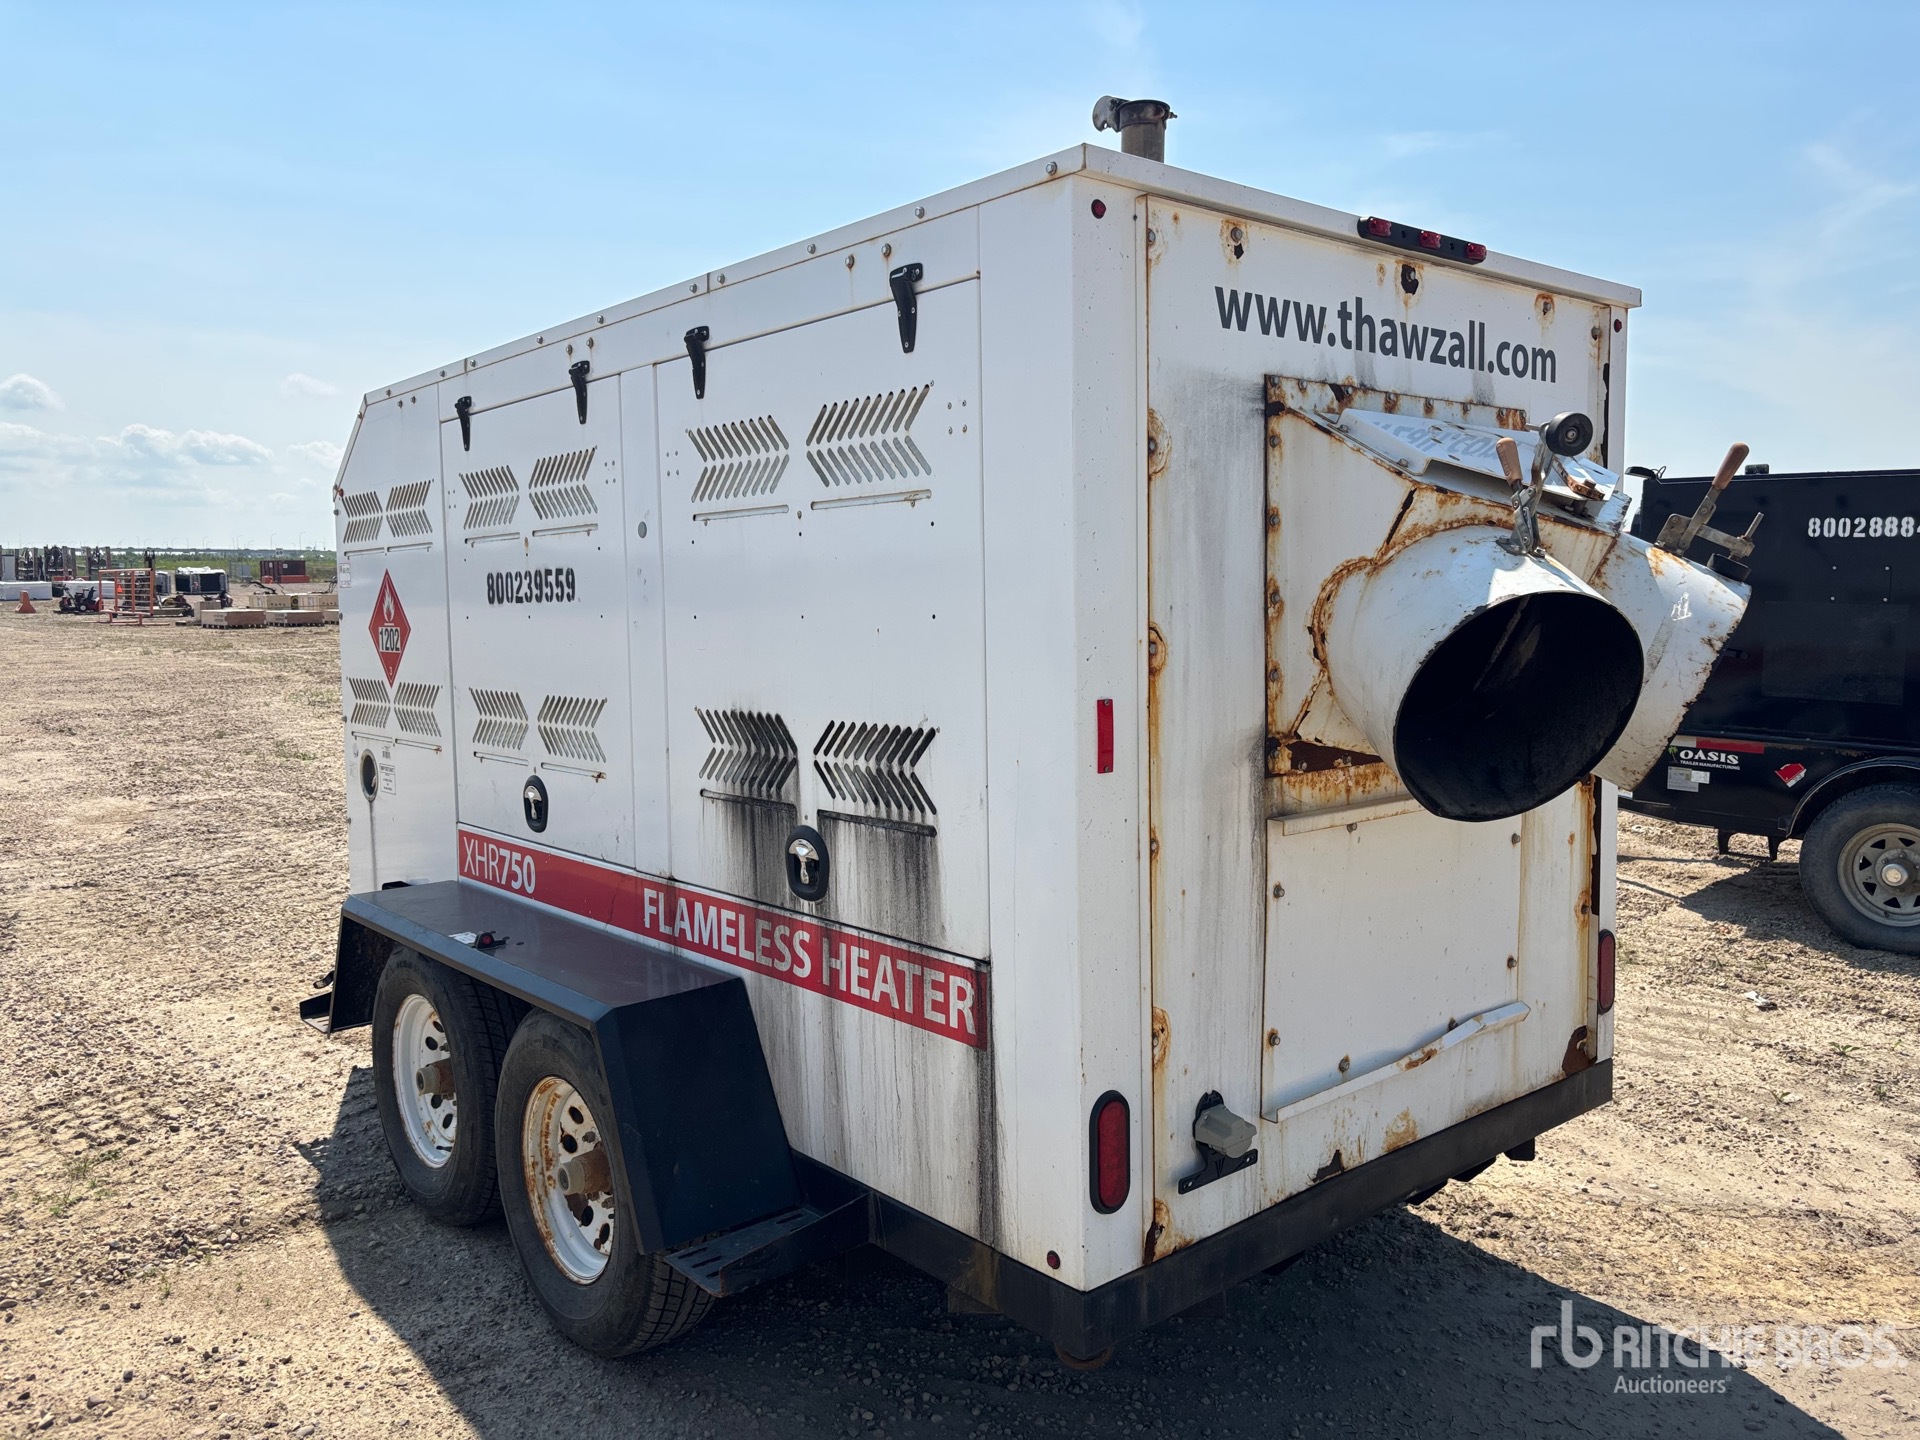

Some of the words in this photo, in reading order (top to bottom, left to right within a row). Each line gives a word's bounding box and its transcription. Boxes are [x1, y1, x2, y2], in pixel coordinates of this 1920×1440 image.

[1214, 285, 1557, 384] www.thawzall.com
[1807, 516, 1920, 538] 8002888
[486, 567, 577, 605] 800239559
[379, 627, 400, 652] 1202
[1679, 748, 1739, 765] OASIS
[1699, 761, 1740, 771] MANUFACTURING
[643, 887, 812, 979] FLAMELESS
[822, 937, 977, 1036] HEATER
